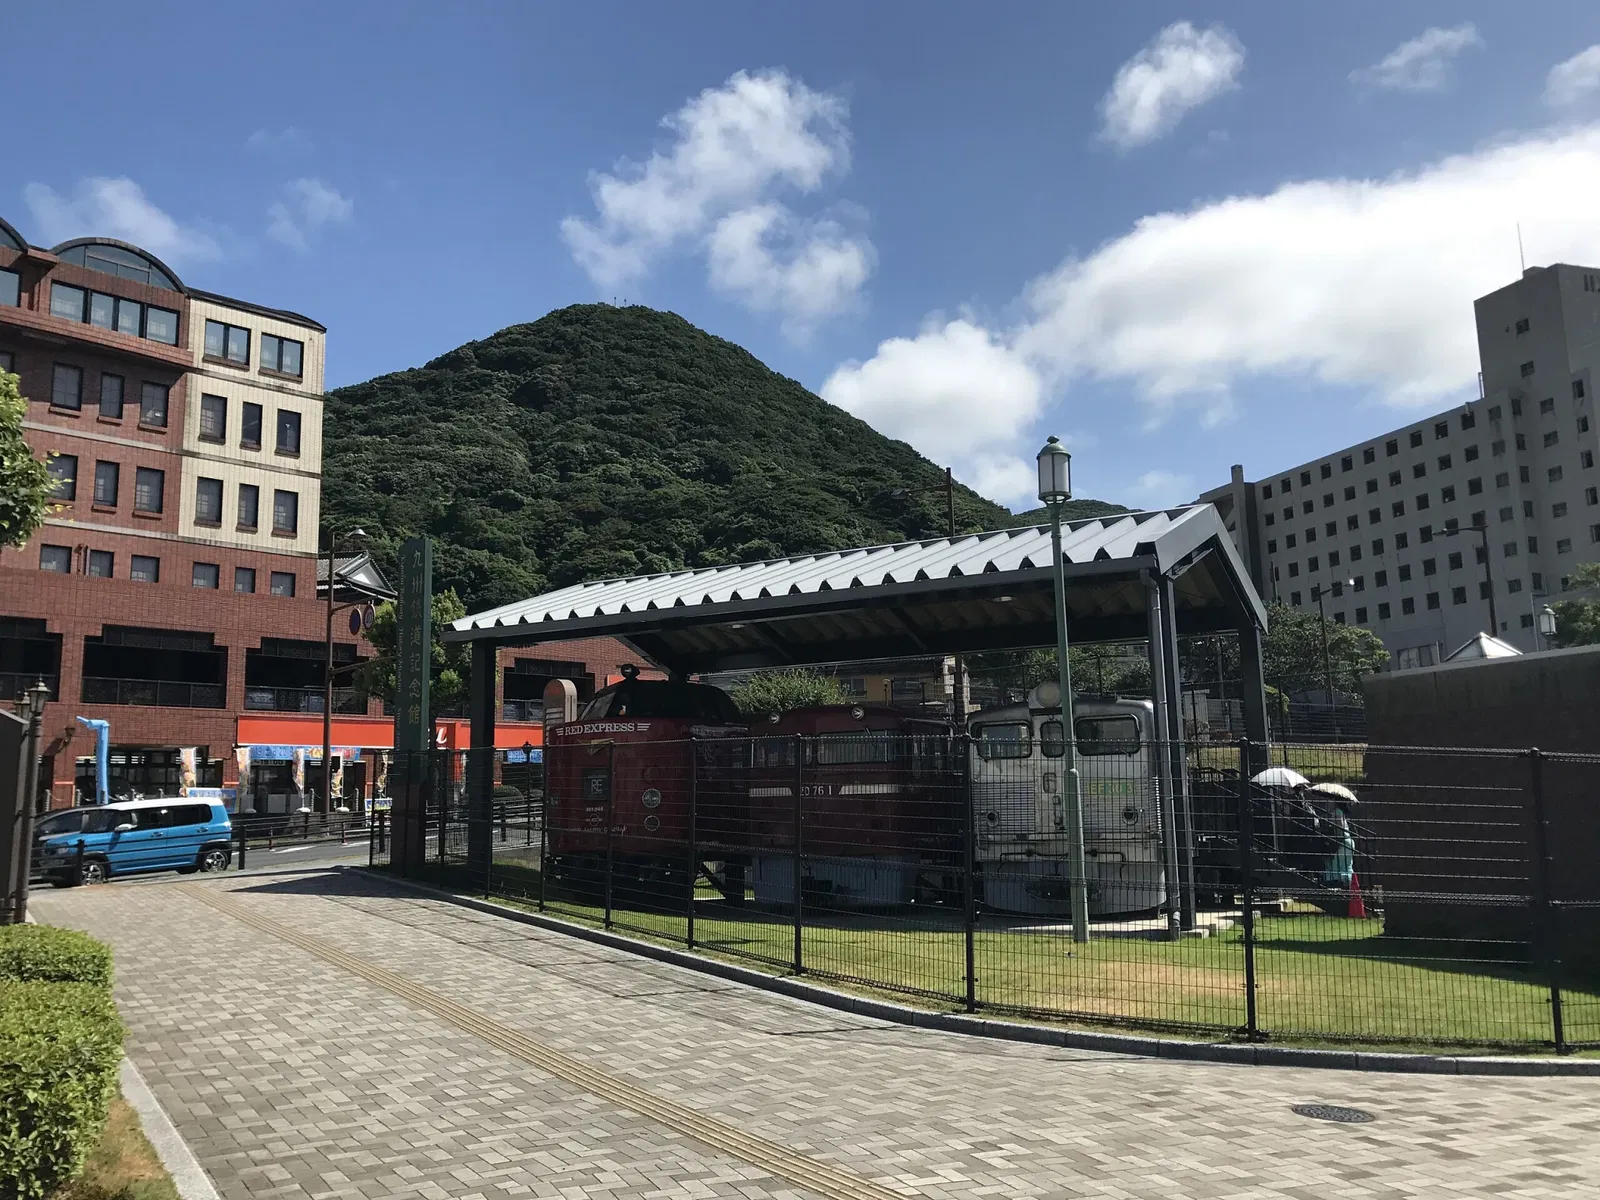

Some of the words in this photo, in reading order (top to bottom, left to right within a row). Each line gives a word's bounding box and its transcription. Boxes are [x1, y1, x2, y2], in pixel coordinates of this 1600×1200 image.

[565, 725, 583, 736] RED
[584, 722, 636, 733] EXPRESS
[812, 785, 824, 796] 76
